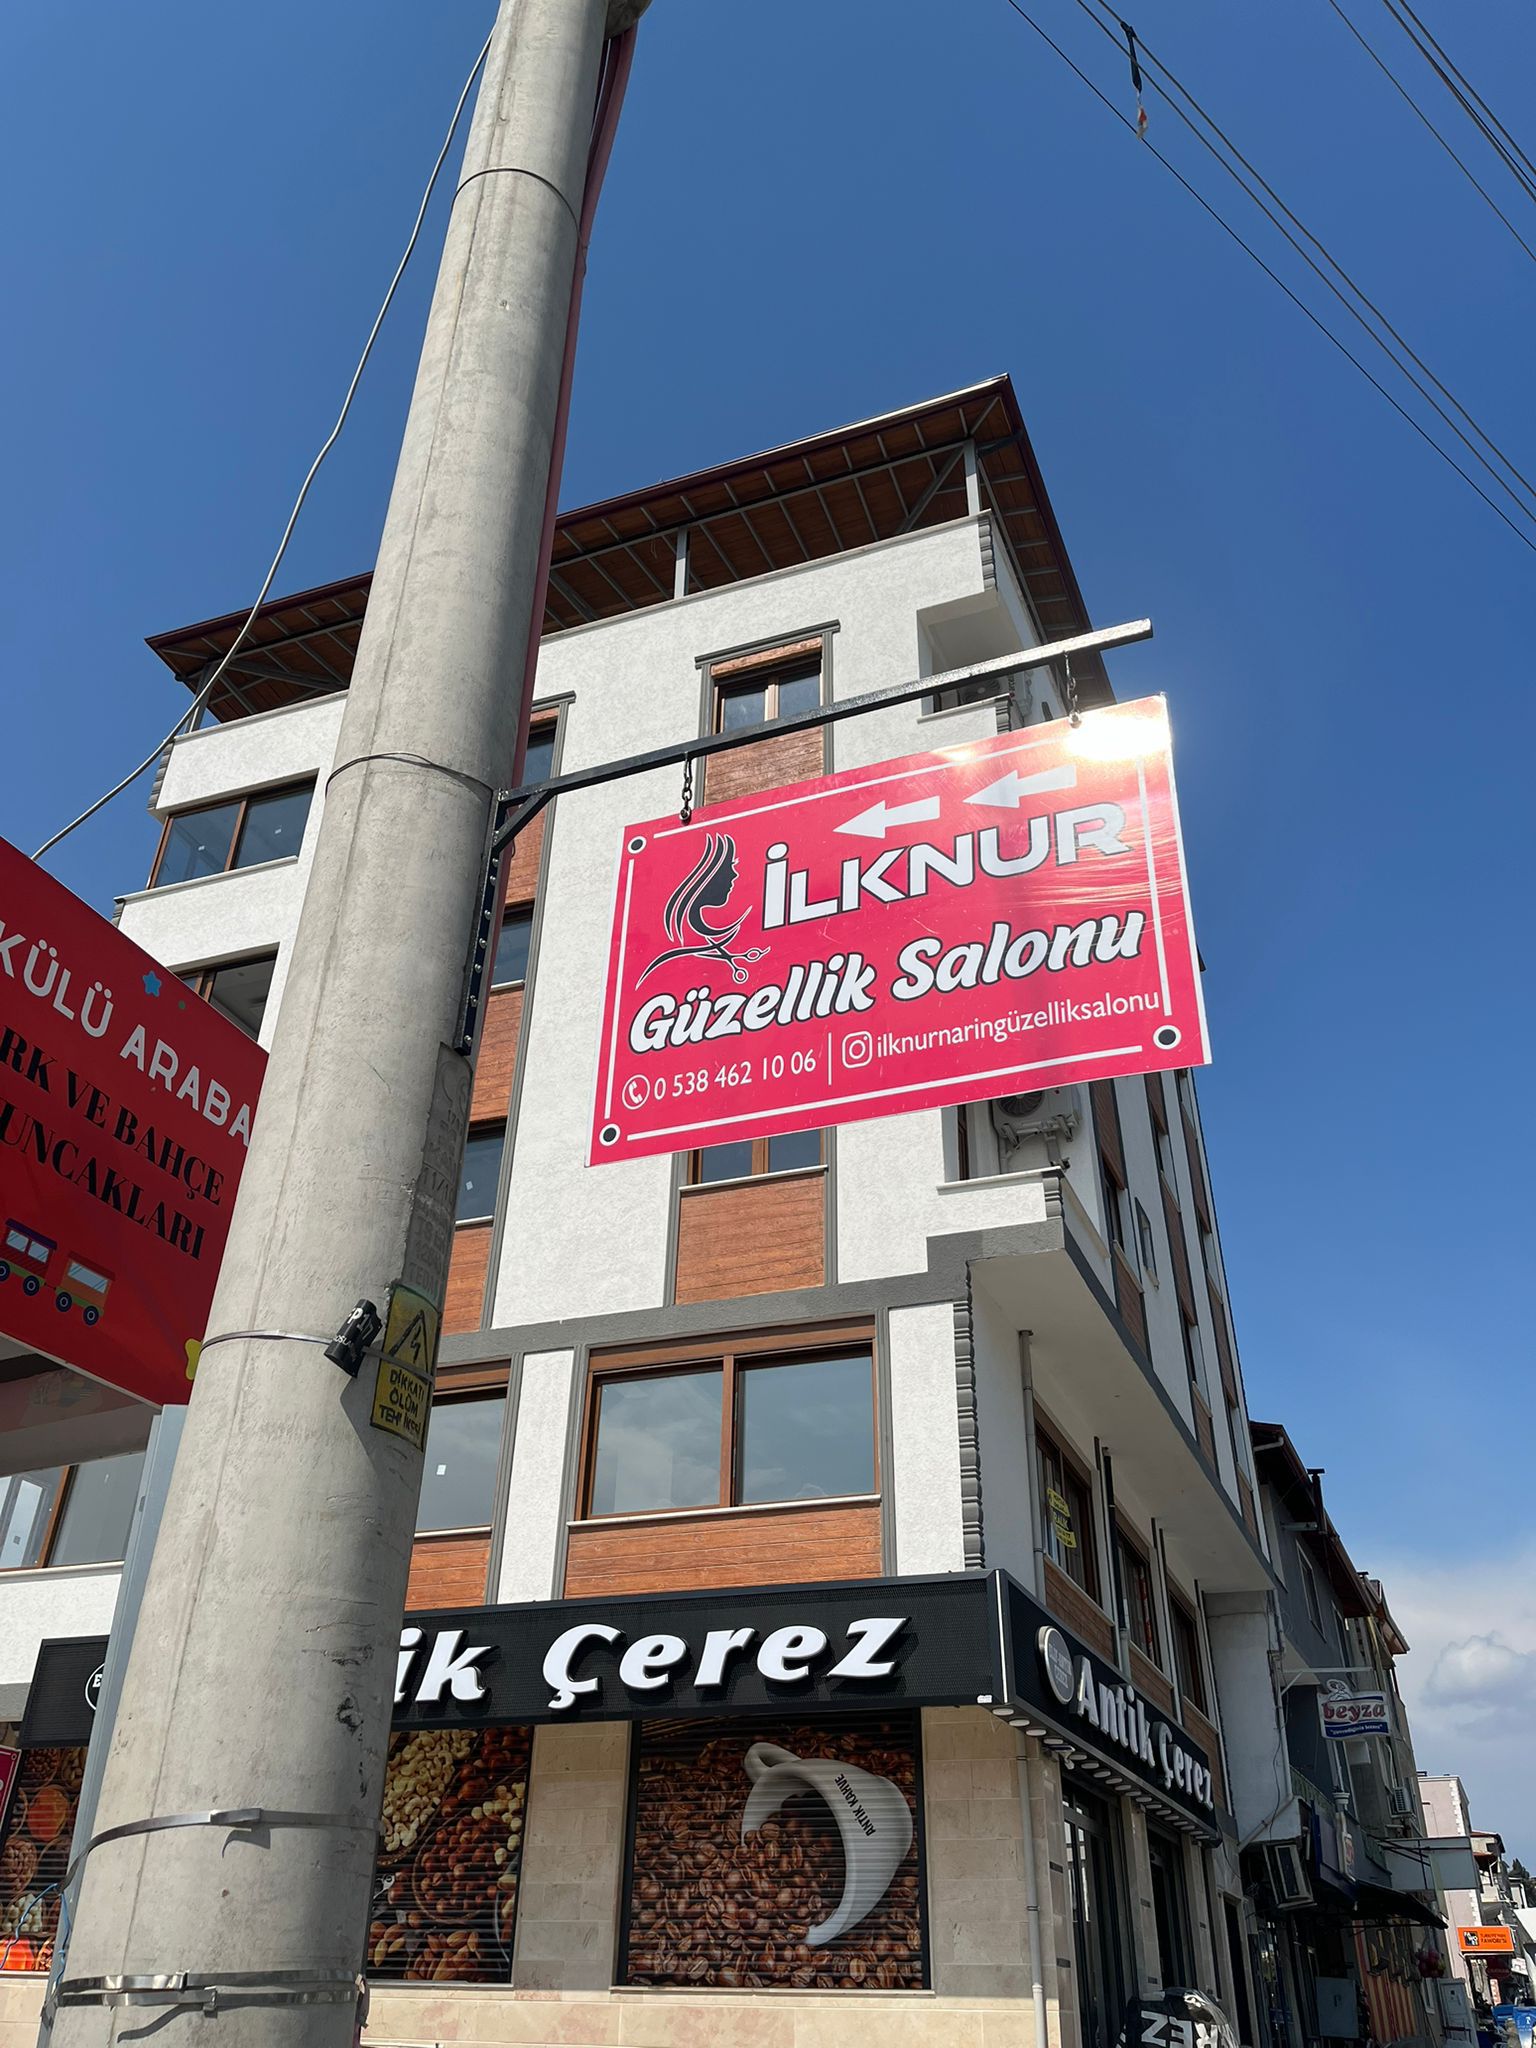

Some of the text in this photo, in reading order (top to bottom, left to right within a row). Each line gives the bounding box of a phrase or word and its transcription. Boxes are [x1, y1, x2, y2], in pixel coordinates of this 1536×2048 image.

[761, 801, 1132, 932] İLKNUR
[628, 910, 1147, 1054] Güzellik Salonu
[876, 991, 1160, 1058] ilknurnaringüzelliksalonu
[654, 1049, 816, 1100] 0 538 462 10 06
[0, 1097, 206, 1261] UNCAKLARI
[66, 1067, 110, 1129] VE
[112, 1105, 224, 1206] BAHÇE
[542, 1616, 912, 1710] Çerez
[1321, 1702, 1386, 1723] beyza
[1070, 1654, 1156, 1769] Antik
[1152, 1720, 1214, 1812] Çerez
[834, 1773, 859, 1808] KAHVE
